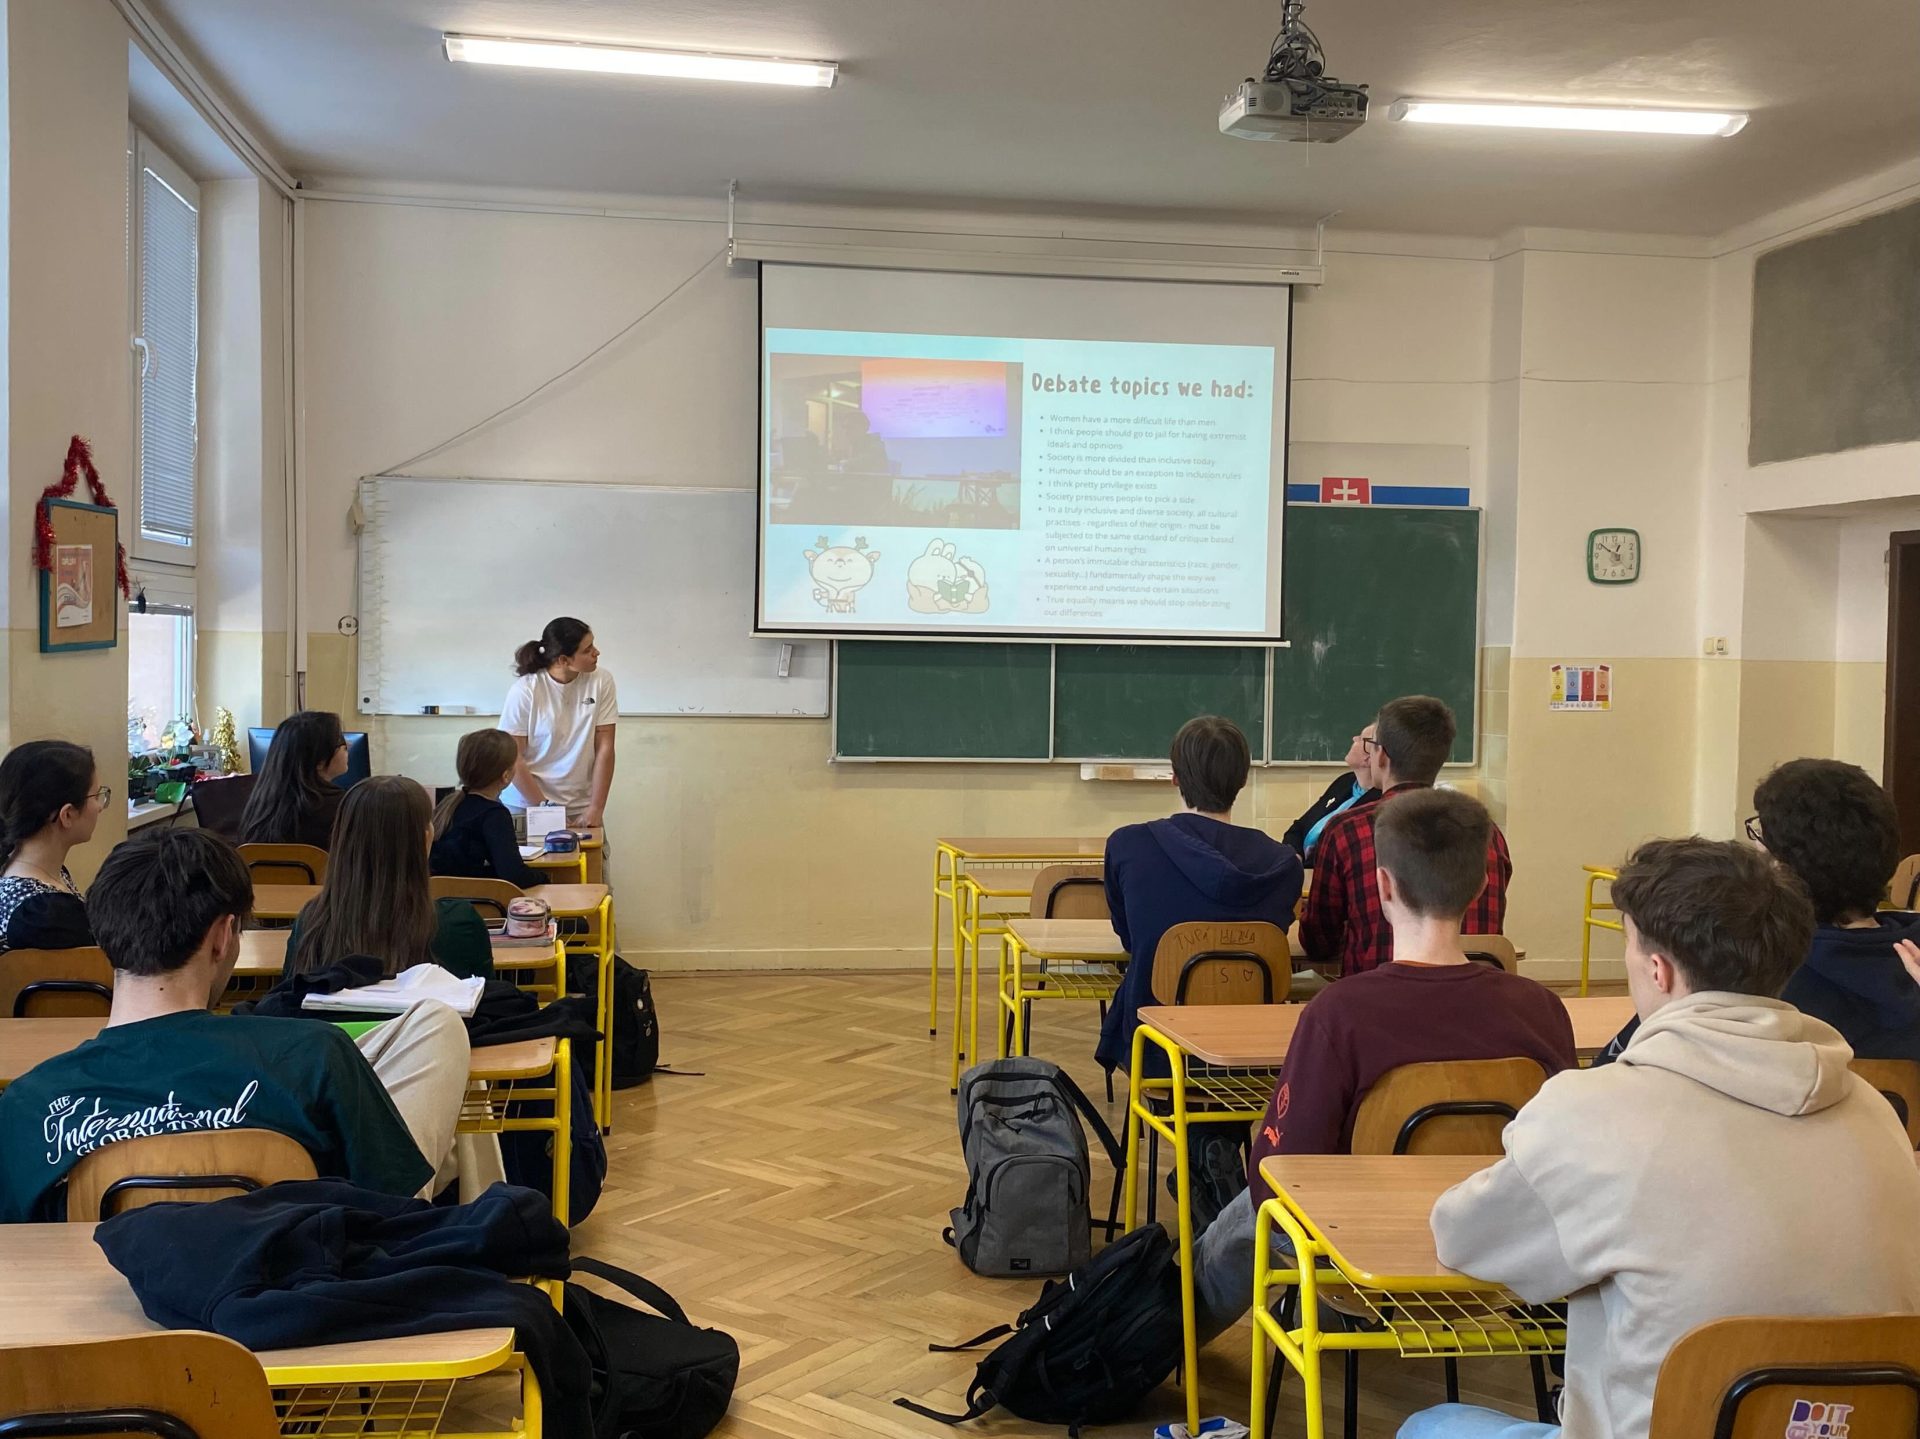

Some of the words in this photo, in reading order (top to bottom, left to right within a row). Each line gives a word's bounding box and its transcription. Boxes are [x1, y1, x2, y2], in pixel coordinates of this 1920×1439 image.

[1032, 373, 1101, 394] Debate
[1110, 376, 1169, 399] topics
[1178, 381, 1202, 397] we
[1211, 380, 1253, 398] had:
[1049, 414, 1081, 423] Women
[1082, 414, 1102, 424] have
[1133, 416, 1163, 425] difficult
[1164, 417, 1176, 426] life
[1178, 417, 1196, 426] than
[1076, 429, 1103, 437] people
[1105, 428, 1132, 437] should
[1154, 431, 1167, 440] jail
[1182, 432, 1208, 441] having
[1047, 440, 1070, 448] ideals
[1072, 441, 1087, 449] and
[1047, 453, 1075, 463] Society
[1076, 454, 1083, 462] is
[1107, 455, 1137, 463] divided
[1138, 456, 1157, 464] than
[1048, 467, 1082, 475] Humour
[1083, 468, 1110, 476] should
[1135, 470, 1174, 478] exception
[1185, 471, 1221, 479] inclusion
[1222, 472, 1242, 480] rules
[1074, 481, 1098, 490] pretty
[1100, 481, 1134, 491] privilege
[1046, 492, 1074, 502] Society
[1116, 495, 1143, 503] people
[1154, 496, 1170, 504] pick
[1064, 506, 1082, 515] truly
[1136, 508, 1164, 516] diverse
[1208, 510, 1238, 518] cultural
[1045, 519, 1081, 527] practises
[1087, 520, 1128, 529] regardless
[1159, 522, 1183, 531] origin
[1045, 531, 1083, 540] subjected
[1169, 534, 1178, 542] of
[1179, 535, 1209, 544] critique
[1094, 545, 1123, 553] human
[1086, 558, 1129, 566] immutable
[1130, 560, 1186, 568] characteristics
[1089, 570, 1145, 581] fundamentally
[1147, 574, 1171, 582] shape
[1187, 575, 1202, 583] way
[1046, 595, 1064, 603] True
[1066, 596, 1097, 606] equality
[1140, 598, 1166, 606] should
[1168, 599, 1186, 607] stop
[48, 1095, 71, 1115] THE
[44, 1079, 259, 1165] Internatinal
[1812, 1423, 1848, 1437] YOUR
